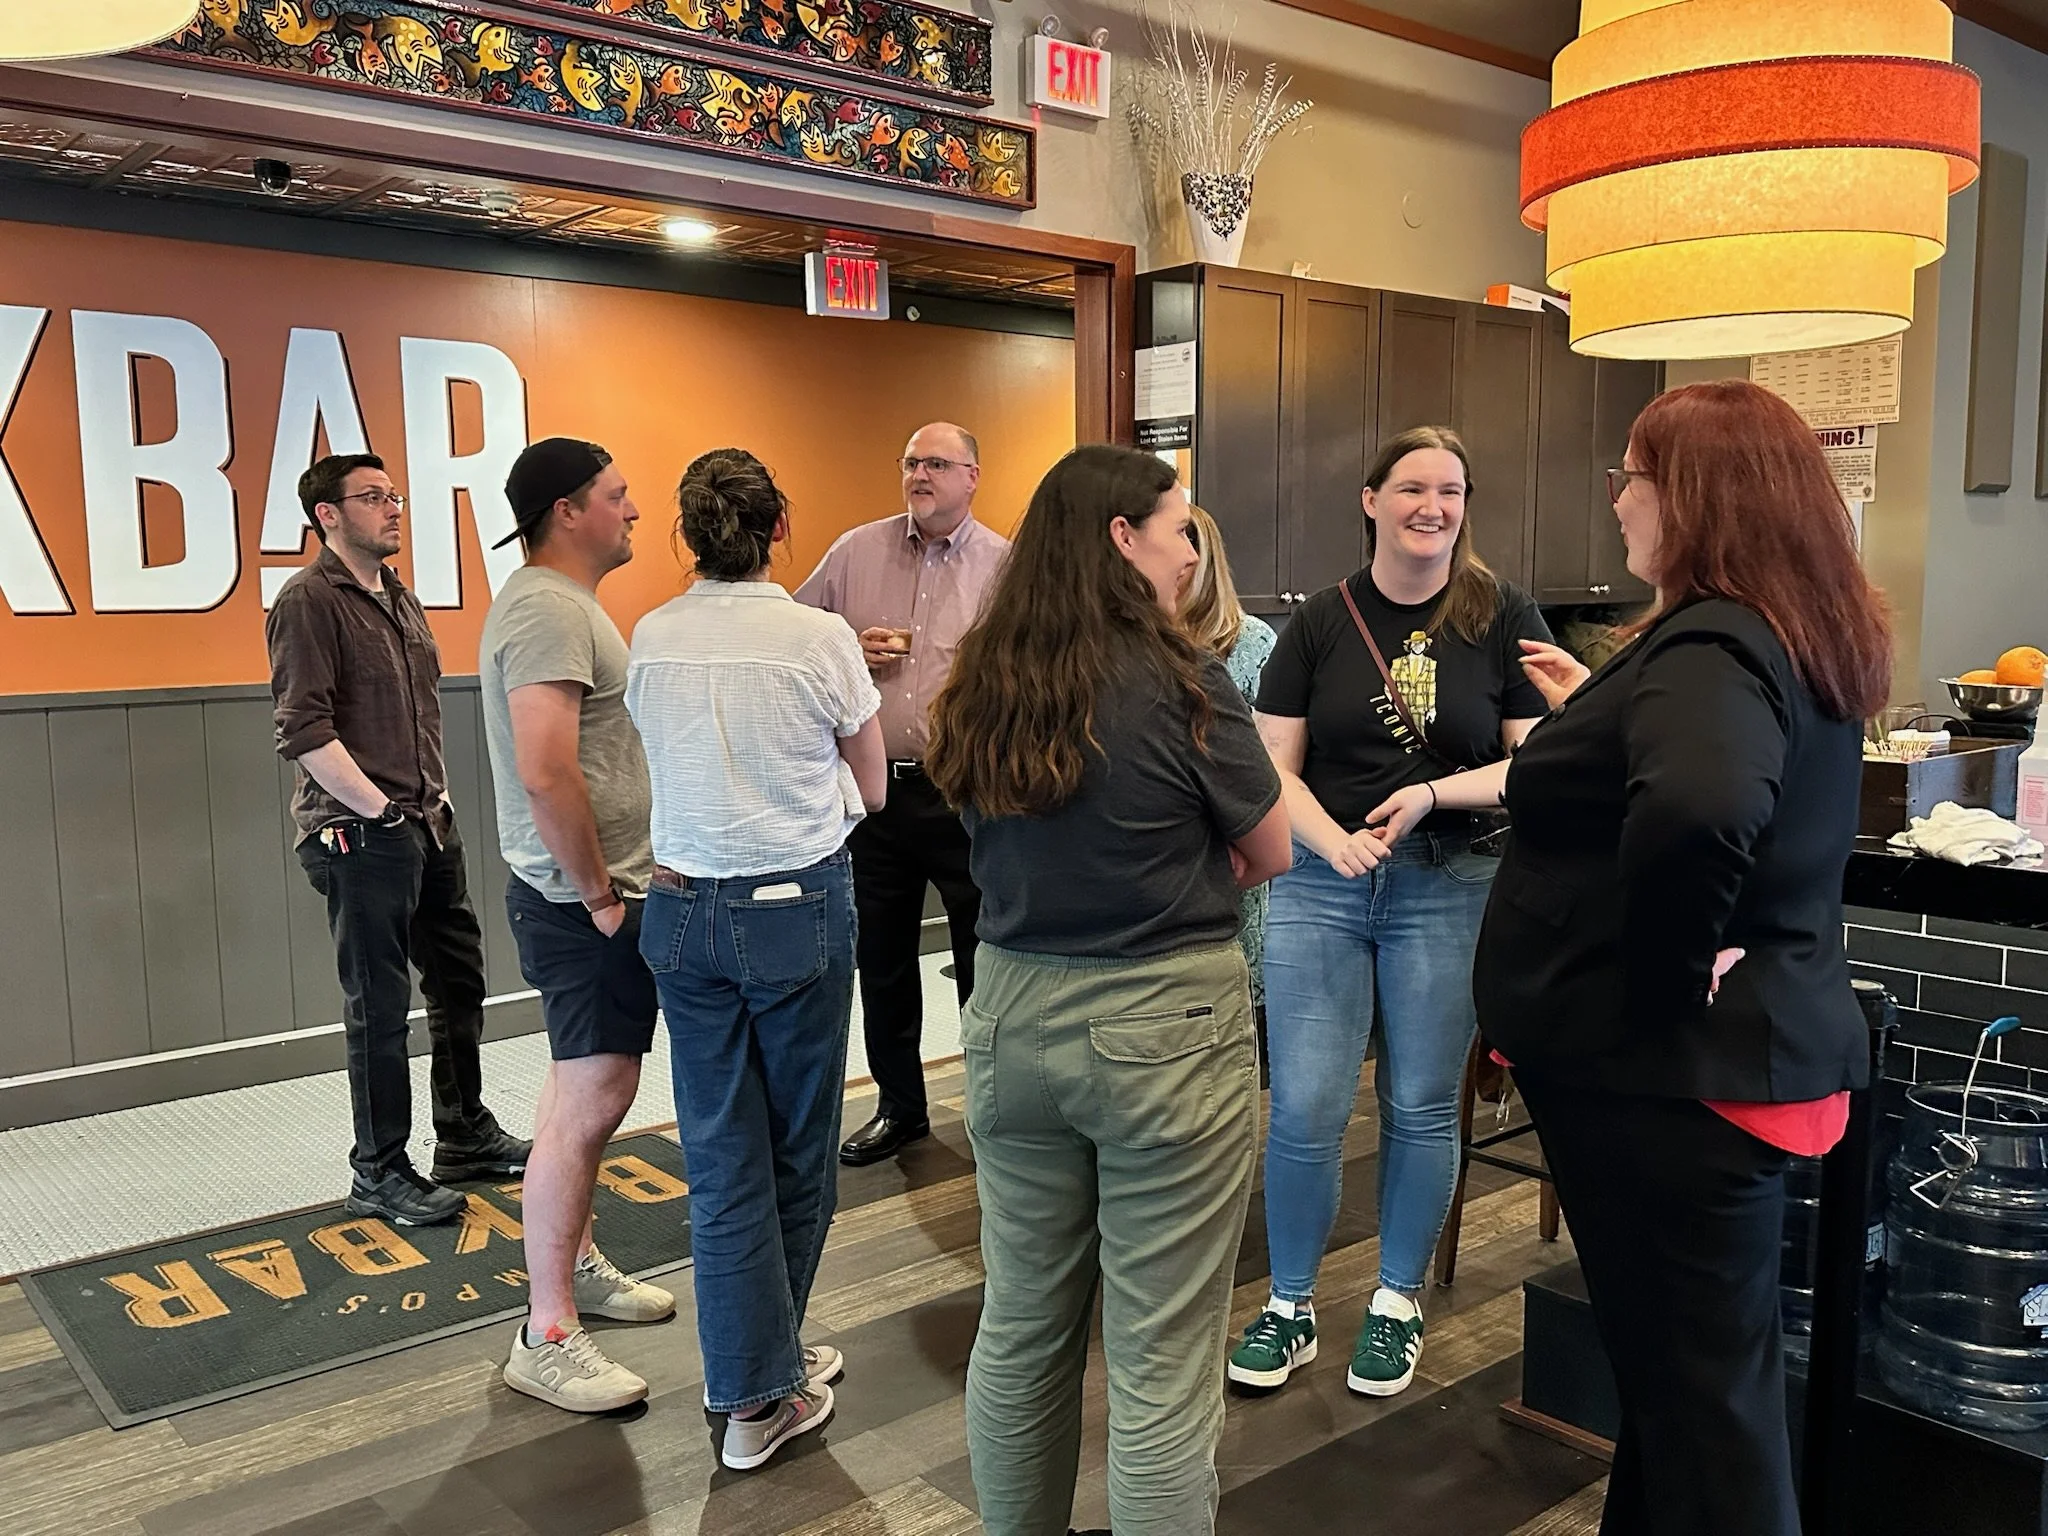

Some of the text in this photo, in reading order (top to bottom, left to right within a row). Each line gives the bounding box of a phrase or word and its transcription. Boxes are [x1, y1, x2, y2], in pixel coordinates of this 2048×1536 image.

[1048, 41, 1102, 107] EXIT
[825, 256, 879, 312] EXIT
[1150, 427, 1179, 435] Responsible
[1179, 425, 1188, 433] For
[1157, 435, 1173, 443] Stolen
[1815, 425, 1865, 448] NING!
[1369, 694, 1422, 754] ICONIC
[336, 1269, 530, 1315] MPO'S
